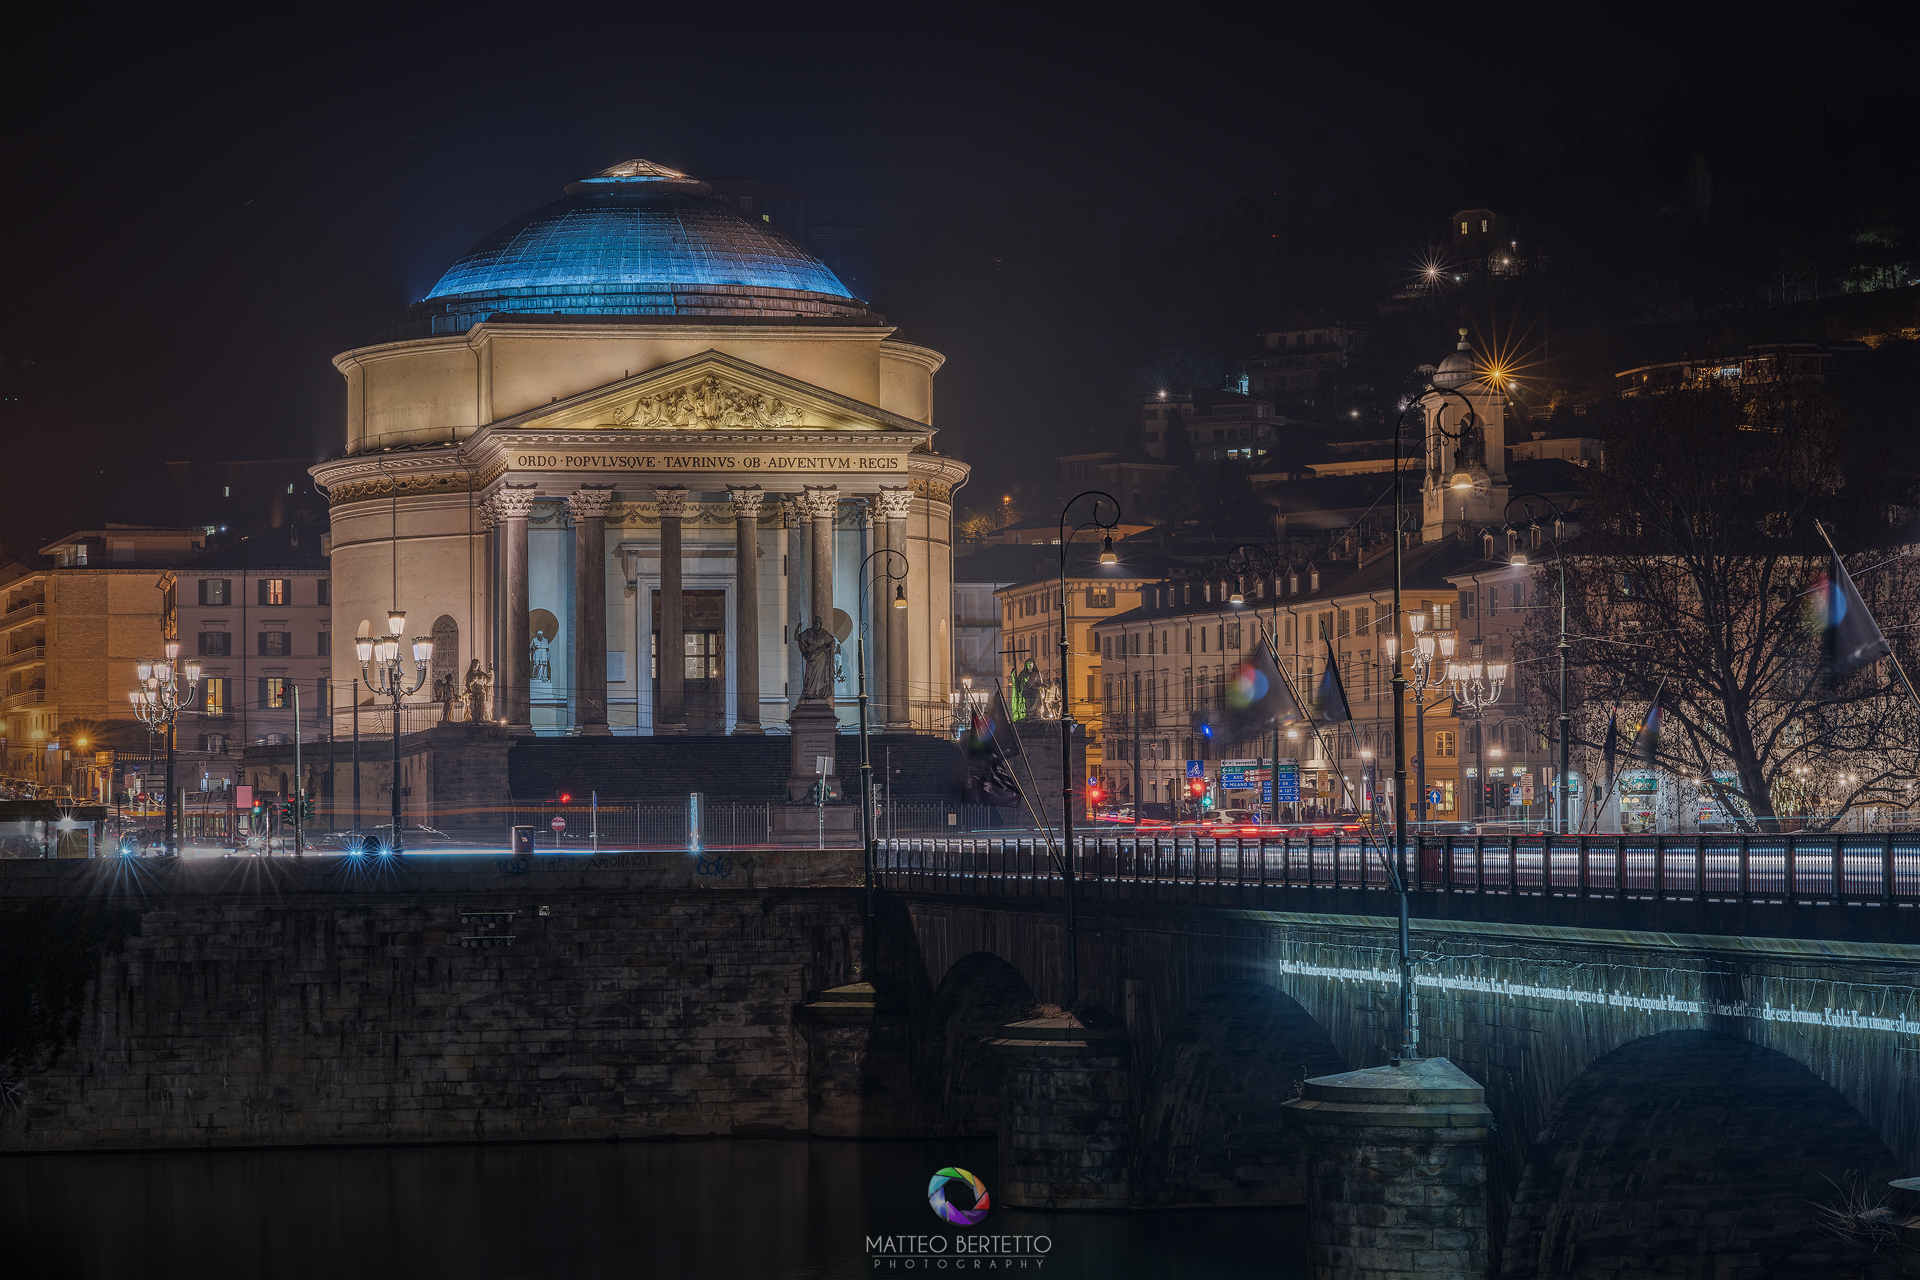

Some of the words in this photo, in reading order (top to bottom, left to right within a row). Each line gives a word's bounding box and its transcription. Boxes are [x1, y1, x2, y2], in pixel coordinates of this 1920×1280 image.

[518, 455, 557, 467] ORDO
[565, 455, 656, 469] POPVLVSQVE
[663, 456, 735, 468] TAVRINVS
[743, 456, 761, 468] OB
[767, 457, 851, 469] ADVENTVM
[858, 457, 898, 469] REGIS
[1763, 1002, 1775, 1020] che
[1776, 1008, 1790, 1022] esse
[1824, 1007, 1852, 1028] Kublai
[1851, 1010, 1868, 1029] Kan
[1868, 1011, 1896, 1032] rimane
